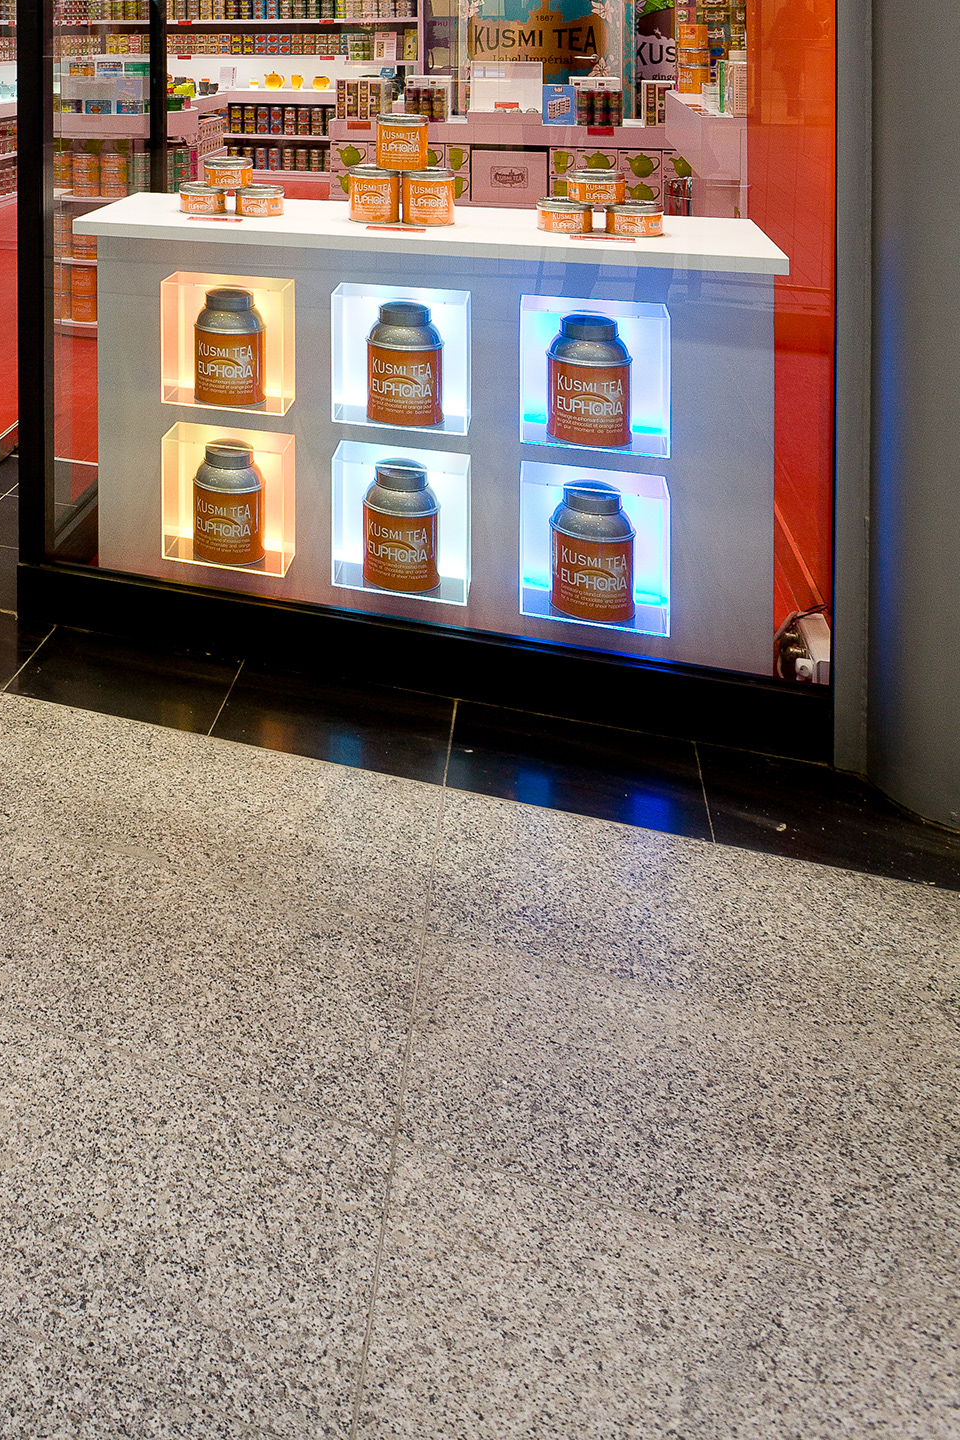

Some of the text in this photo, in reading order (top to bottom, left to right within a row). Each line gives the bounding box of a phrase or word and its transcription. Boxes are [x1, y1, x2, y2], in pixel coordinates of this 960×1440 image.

[535, 15, 555, 23] 1867
[473, 24, 598, 56] KUSMI TEA
[493, 53, 573, 65] Label Impérial
[382, 129, 420, 141] KUSMI TEA
[382, 142, 420, 152] EUPHORIA
[355, 181, 391, 193] KUSMI TEA
[410, 184, 449, 196] KUSMI TEA
[586, 183, 606, 191] KUSMI
[354, 194, 391, 205] EUPHORIA
[410, 197, 449, 208] EUPHORIA
[586, 192, 617, 200] EUPHORIA
[573, 213, 583, 221] TEA
[615, 214, 646, 224] KUSMI TEA
[614, 225, 646, 233] EUPHORIA
[198, 340, 253, 360] KUSMI TEA
[198, 360, 253, 378] EUPHORIA
[372, 356, 432, 379] KUSMI TEA
[372, 378, 432, 397] EUPHORIA
[557, 372, 623, 396] KUSMI TEA
[556, 395, 623, 416] EUPHORIA
[196, 496, 251, 519] KUSMI TEA
[196, 516, 251, 537] EUPHORIA
[368, 518, 428, 544] KUSMI TEA
[368, 540, 428, 563] EUPHORIA
[561, 545, 627, 571] KUSMI TEA
[561, 567, 628, 592] EUPHORIA
